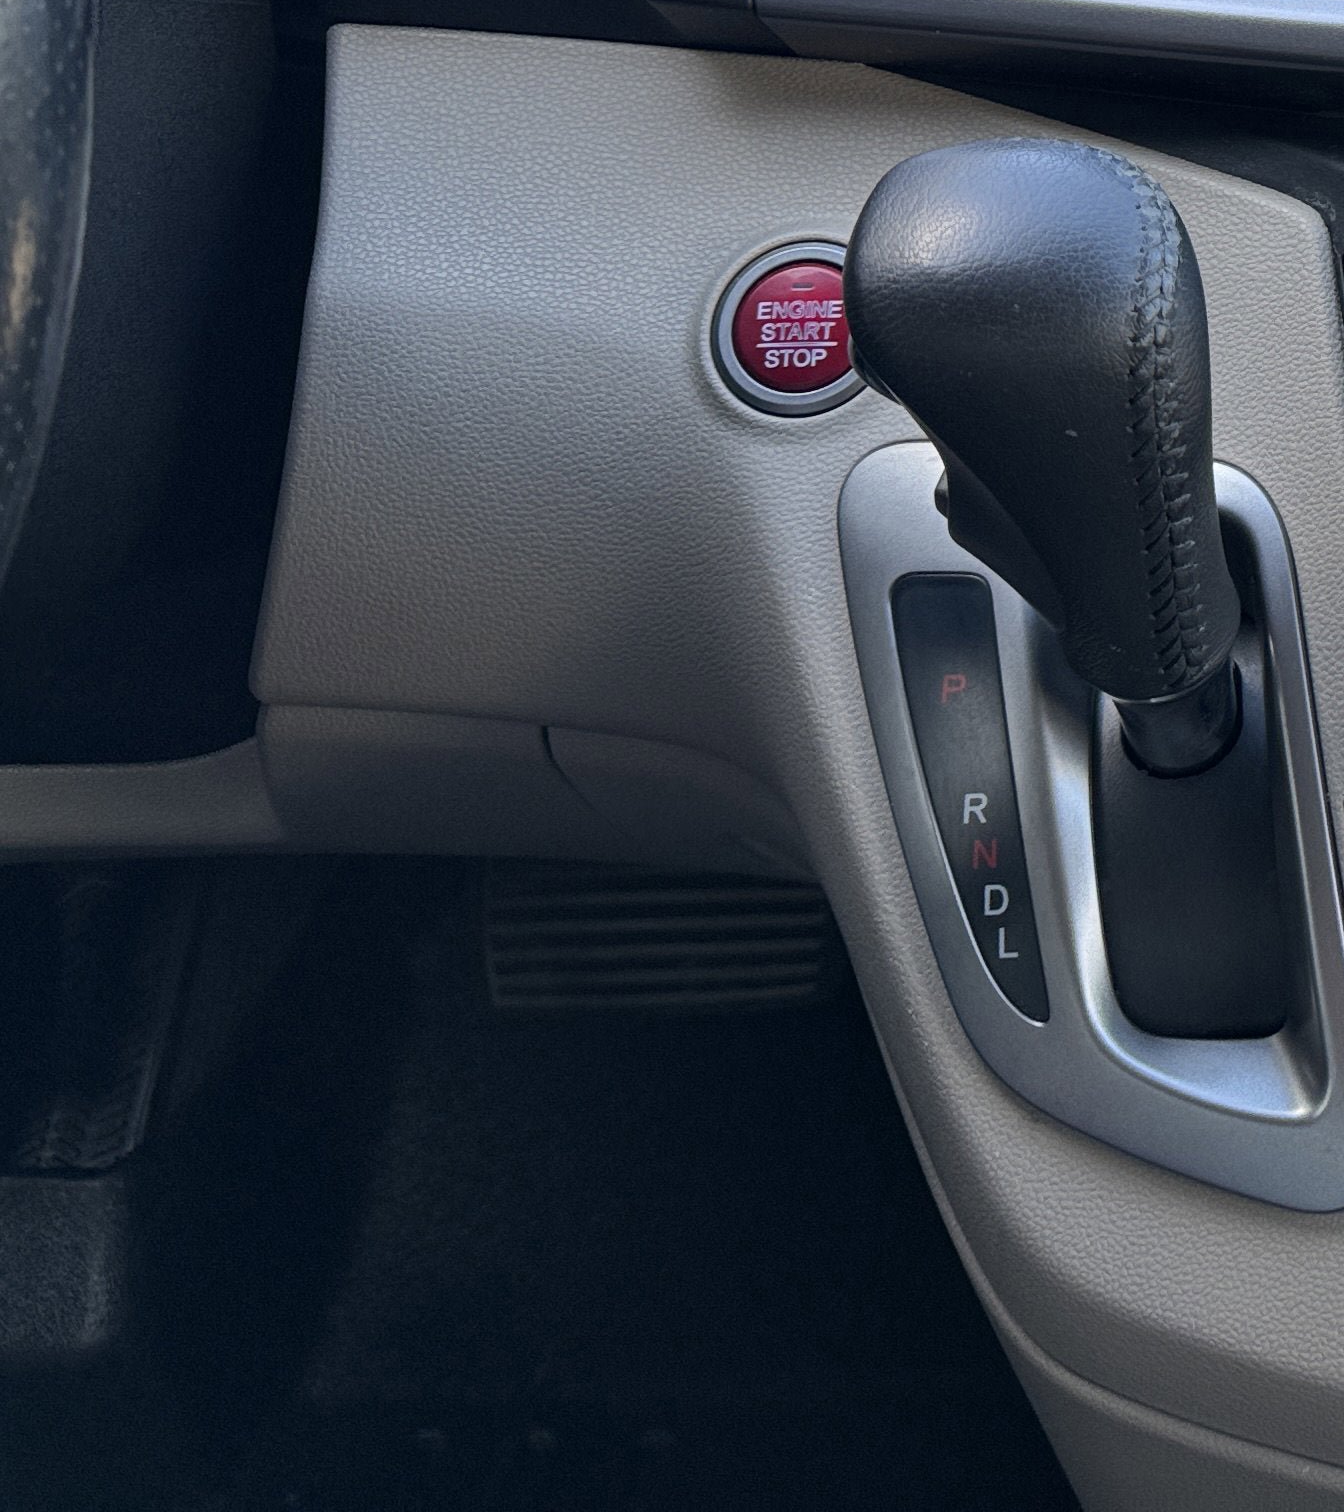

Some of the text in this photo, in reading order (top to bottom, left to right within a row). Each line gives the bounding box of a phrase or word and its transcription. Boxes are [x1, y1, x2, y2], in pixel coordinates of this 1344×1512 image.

[756, 299, 844, 320] ENGINE
[760, 321, 837, 342] START
[763, 348, 828, 368] STOP
[940, 673, 967, 704] P
[963, 792, 988, 824] R
[972, 839, 998, 869] N
[983, 884, 1009, 916] D
[998, 927, 1019, 959] L
